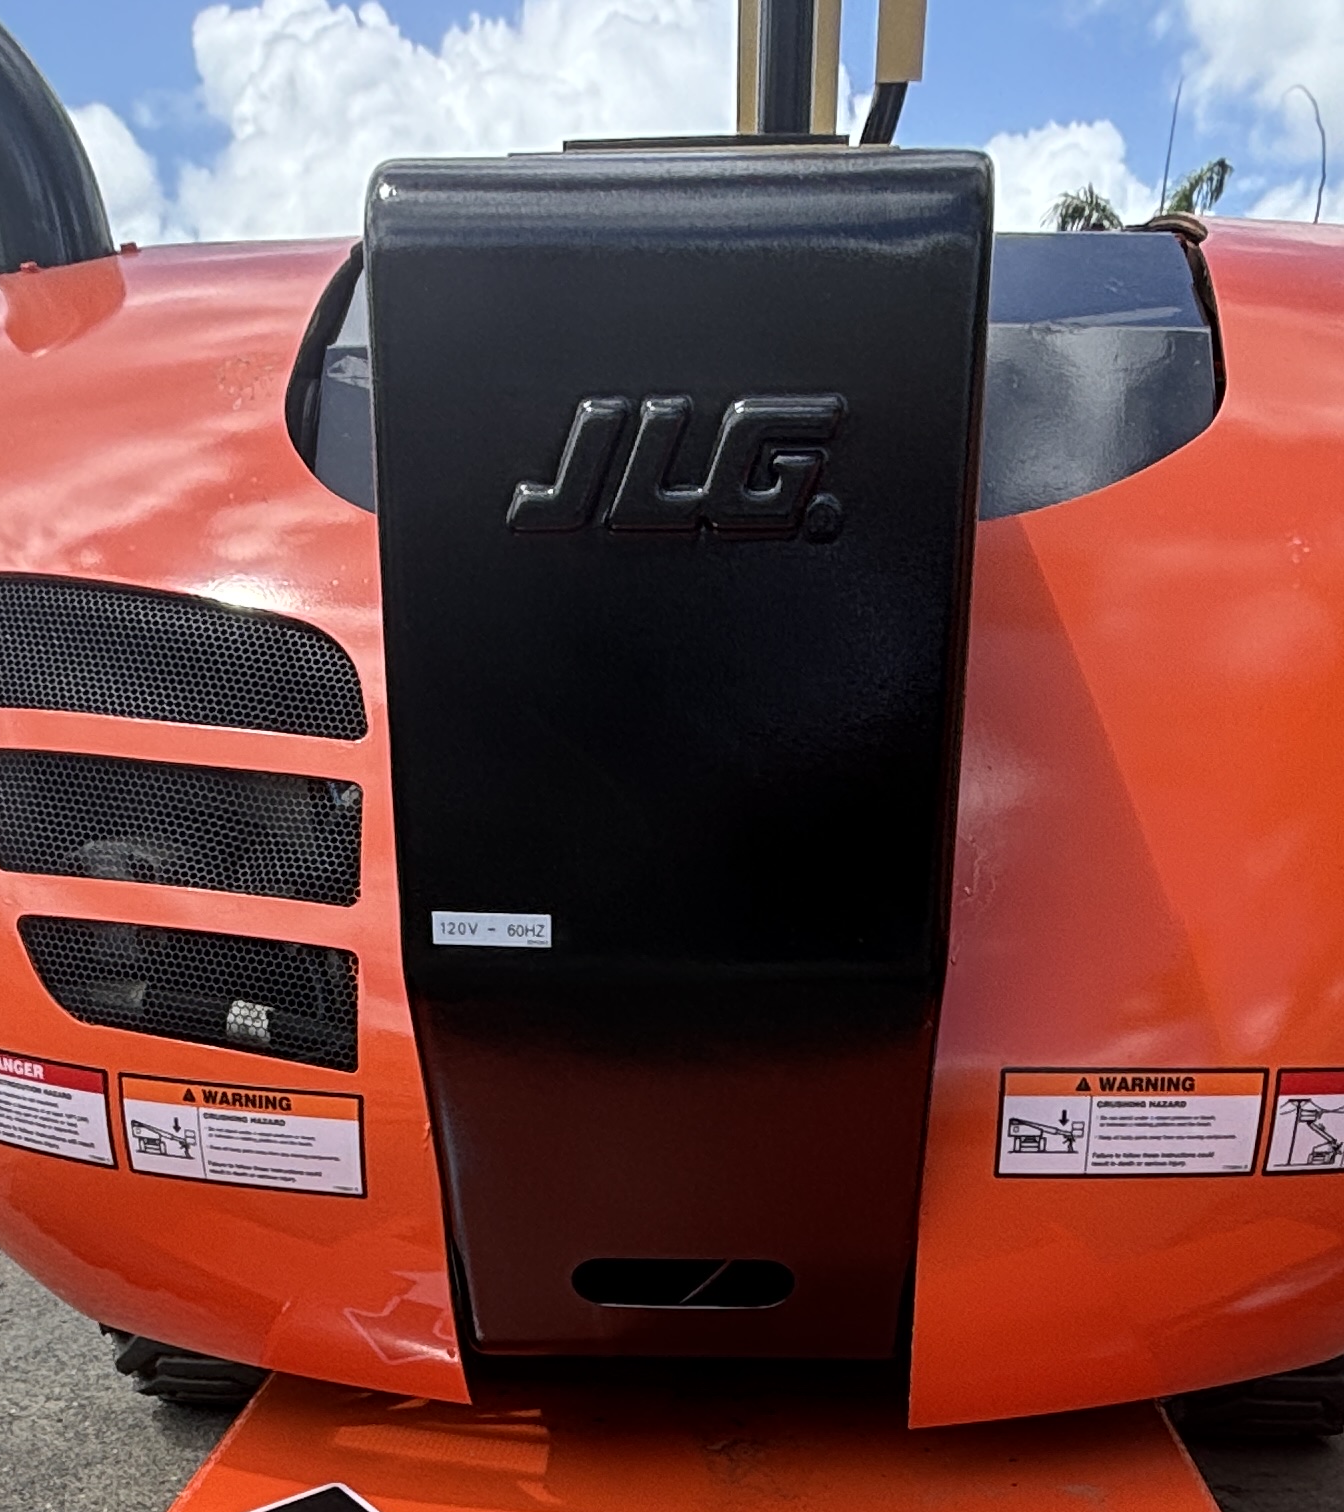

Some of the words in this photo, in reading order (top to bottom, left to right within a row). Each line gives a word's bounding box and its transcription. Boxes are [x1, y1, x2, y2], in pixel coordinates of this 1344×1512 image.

[441, 922, 478, 935] 120V
[507, 924, 545, 937] 60HZ
[1099, 1077, 1196, 1092] WARNING
[201, 1089, 292, 1111] WARNING
